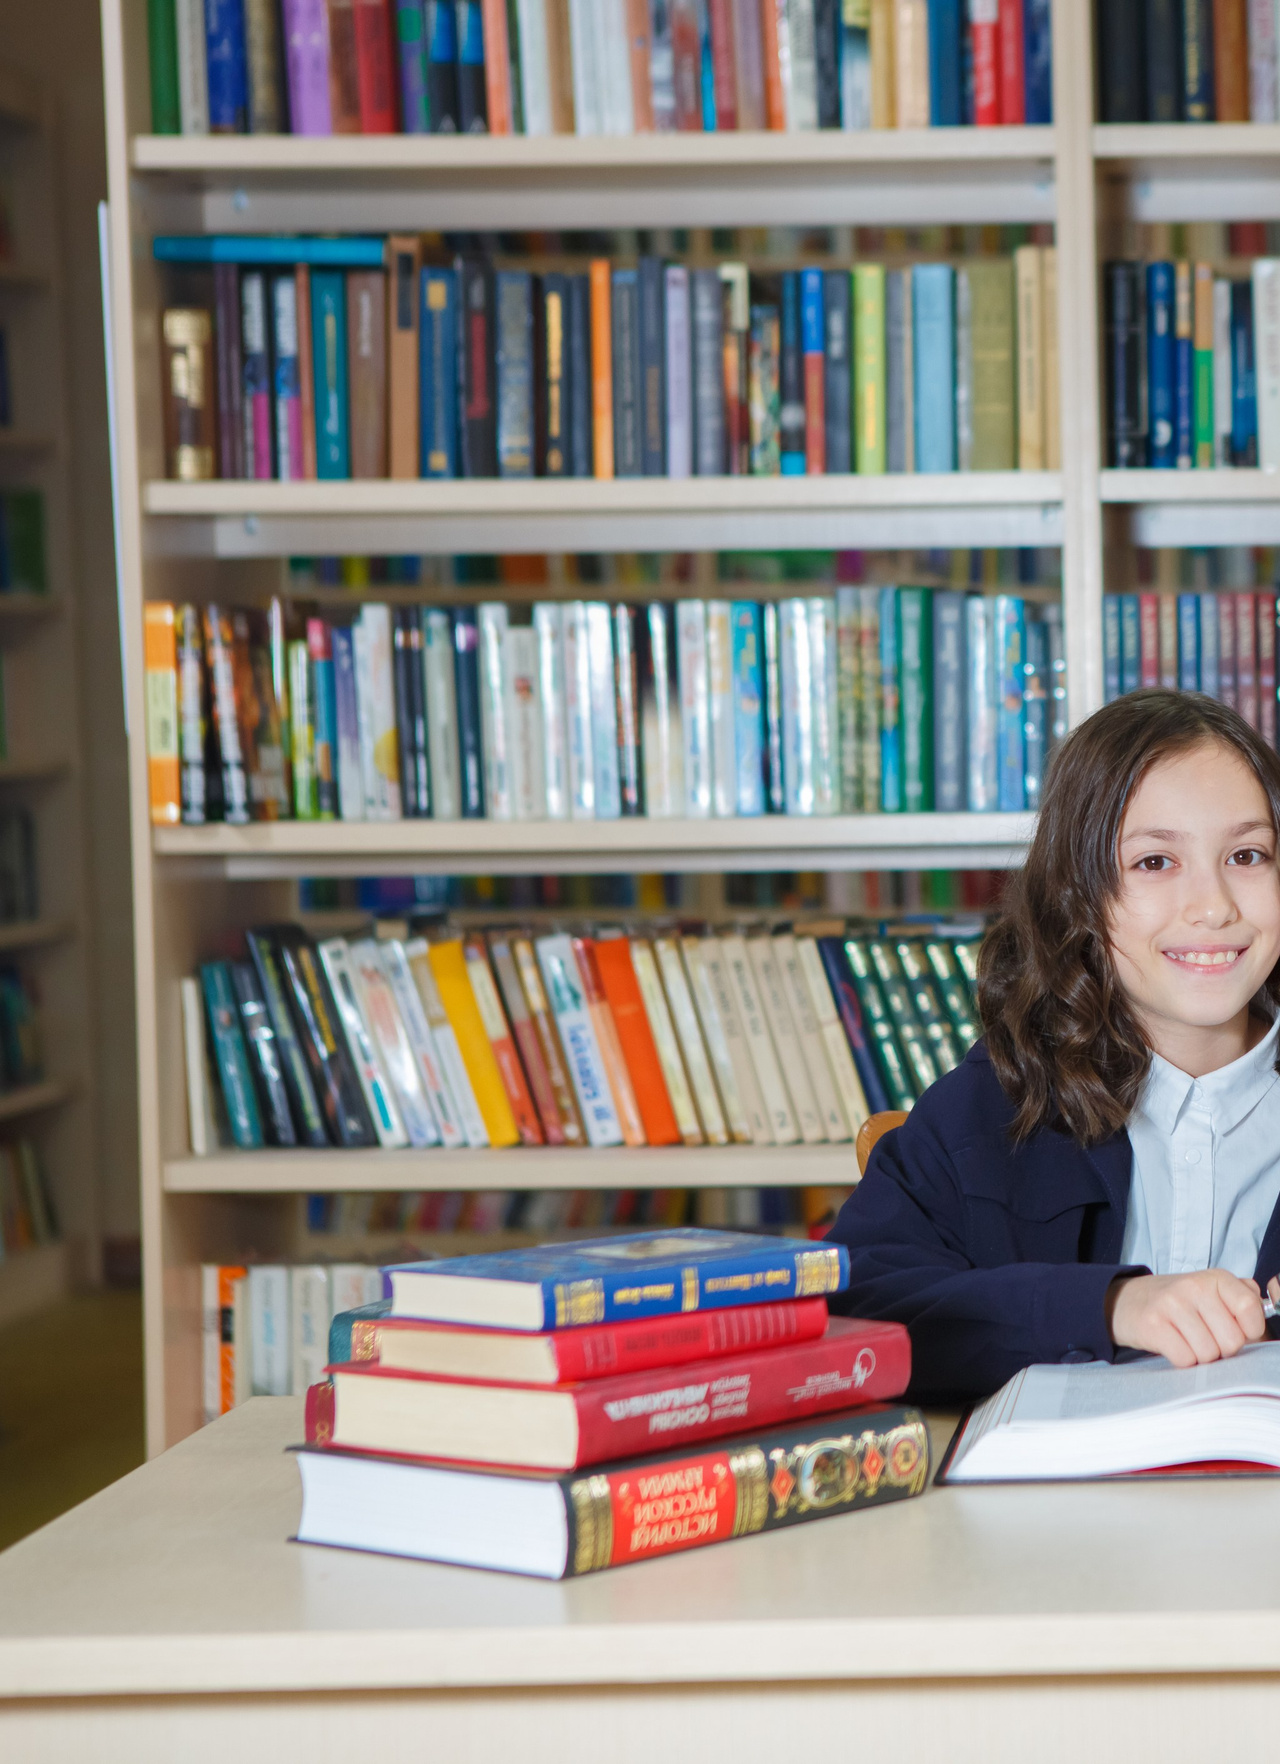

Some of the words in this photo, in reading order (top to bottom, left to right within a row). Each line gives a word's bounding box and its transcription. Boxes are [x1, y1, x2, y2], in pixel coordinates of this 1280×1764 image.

[647, 1402, 710, 1434] ОСНОВЫ
[637, 1465, 704, 1500] АРМИИ
[633, 1486, 718, 1527] РУССКОЙ
[630, 1510, 718, 1553] ИСТОРИЯ
